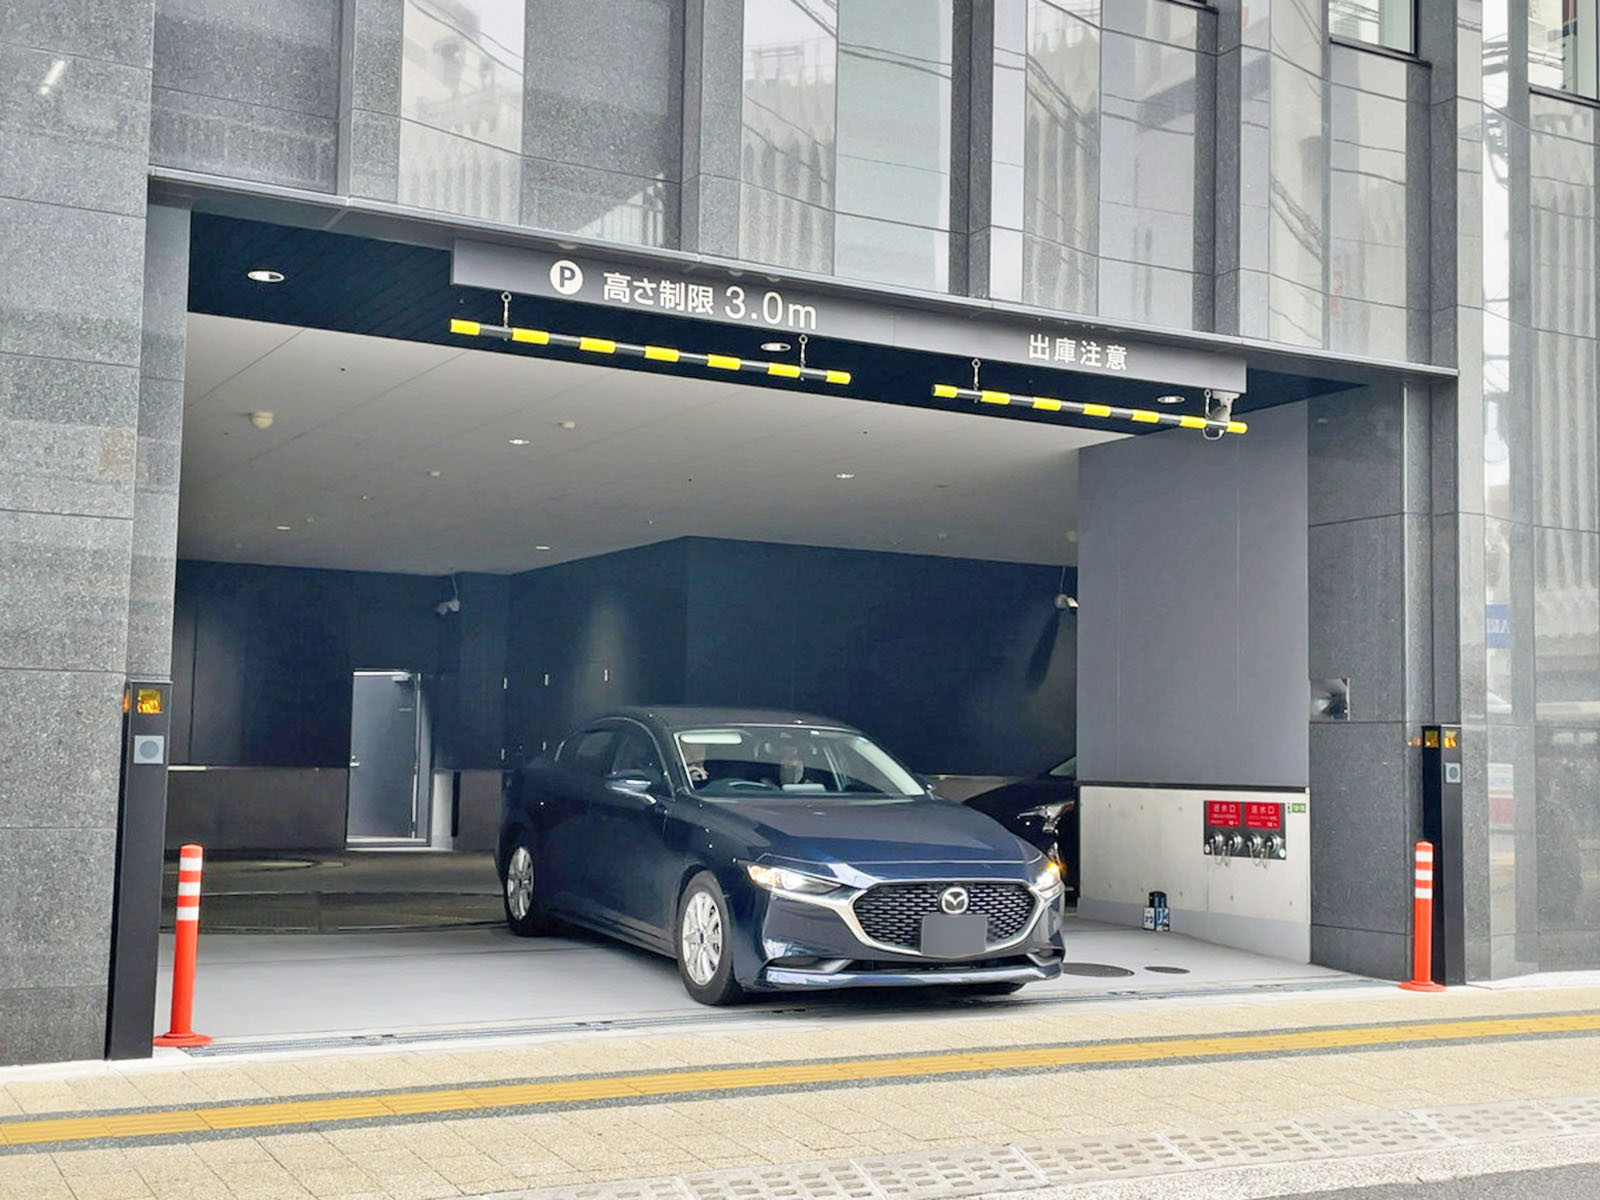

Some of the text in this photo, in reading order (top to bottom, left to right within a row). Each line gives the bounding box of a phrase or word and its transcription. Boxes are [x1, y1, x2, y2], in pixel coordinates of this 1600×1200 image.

[603, 271, 714, 315] 高さ制限
[724, 286, 817, 330] 3.0m
[1028, 333, 1127, 370] 出庫注意
